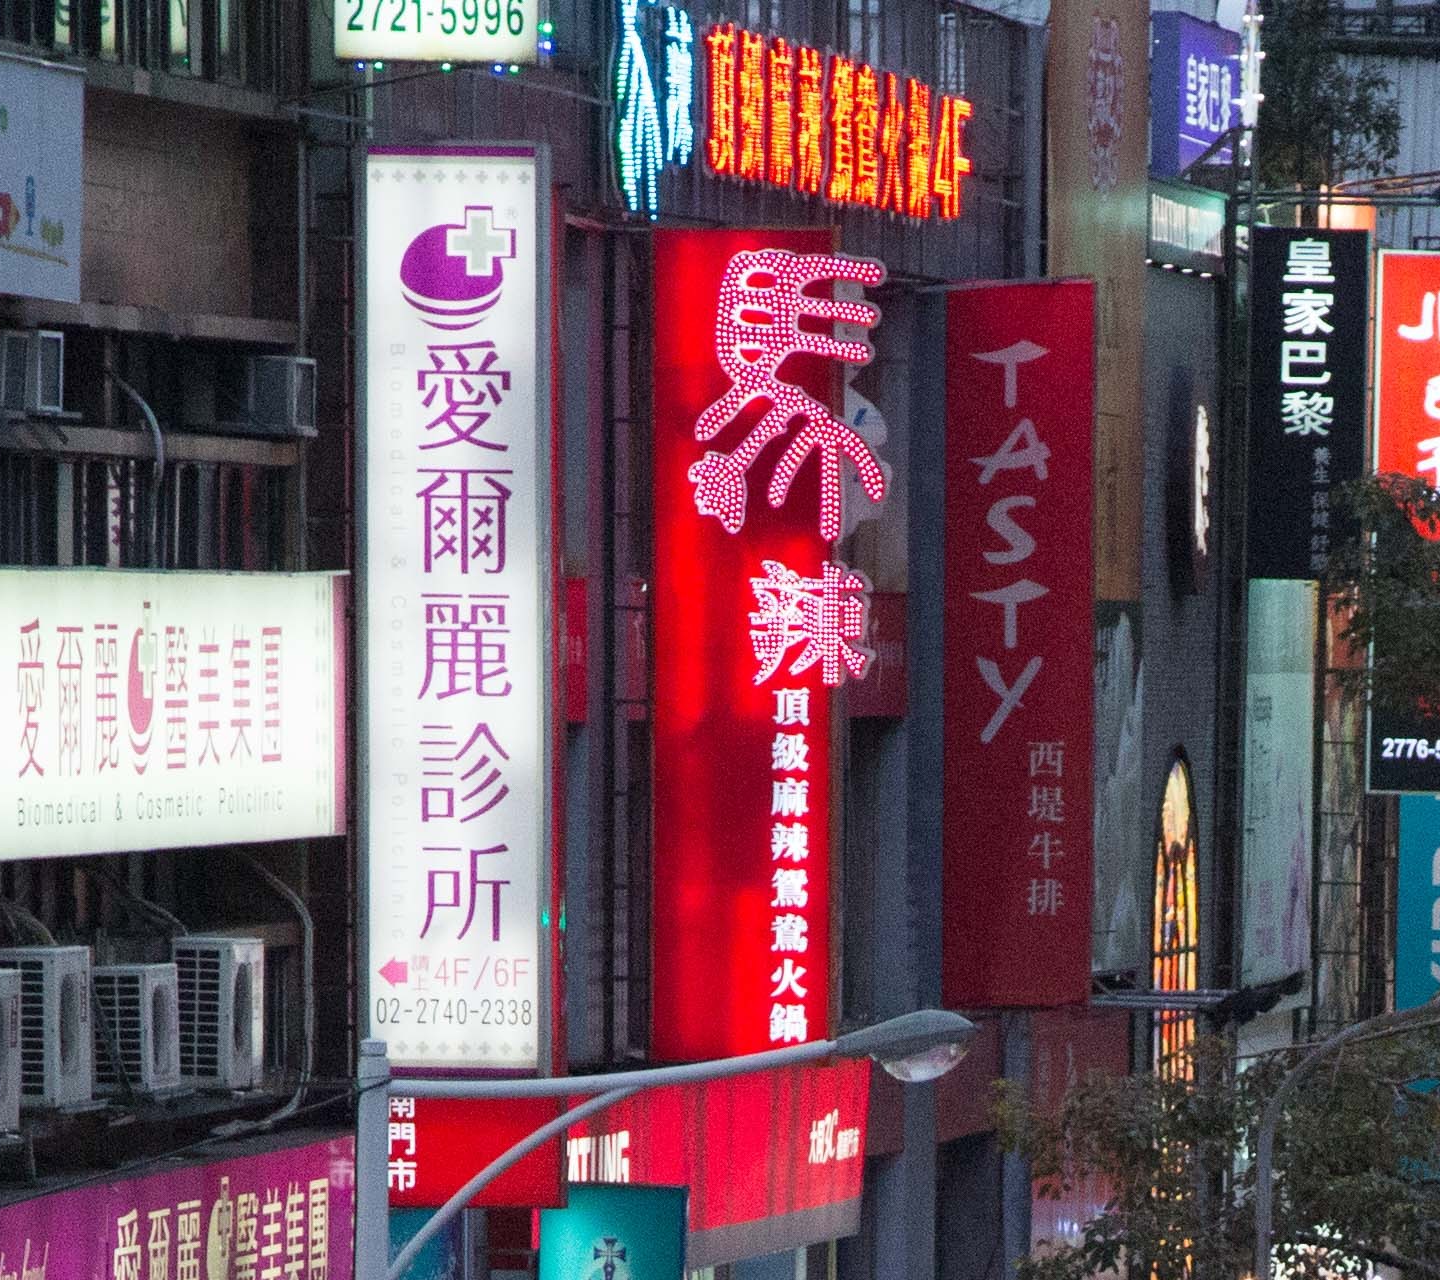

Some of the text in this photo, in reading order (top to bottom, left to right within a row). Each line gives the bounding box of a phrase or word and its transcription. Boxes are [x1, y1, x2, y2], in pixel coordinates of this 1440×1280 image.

[1279, 238, 1336, 437] 皇家巴黎
[969, 340, 1051, 743] TASTY
[415, 340, 515, 943] 愛爾麗診所
[770, 687, 811, 1044] 頂級麻辣鴛鴦火鍋
[1026, 741, 1065, 917] 西堤牛排
[375, 996, 534, 1027] 02-2740-2338
[434, 956, 531, 990] 4F/6F
